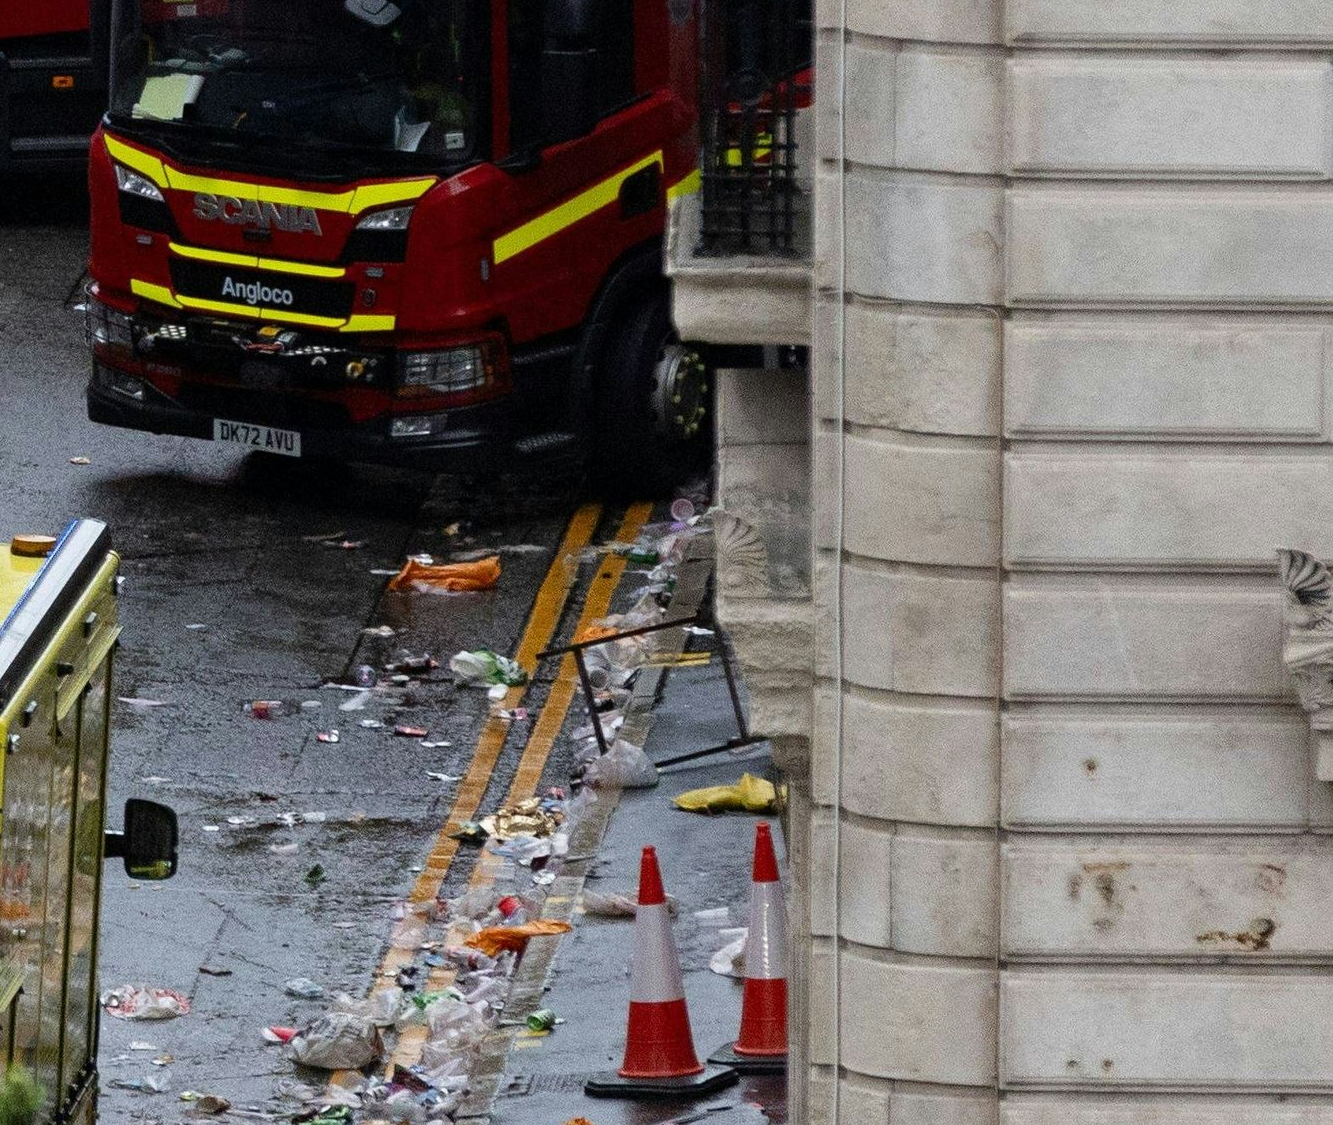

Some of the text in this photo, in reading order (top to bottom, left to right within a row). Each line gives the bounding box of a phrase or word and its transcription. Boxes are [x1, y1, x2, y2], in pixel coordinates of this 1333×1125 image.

[193, 191, 323, 236] SCANIA
[221, 276, 293, 305] Angloco
[220, 422, 295, 452] DK72 AVU
